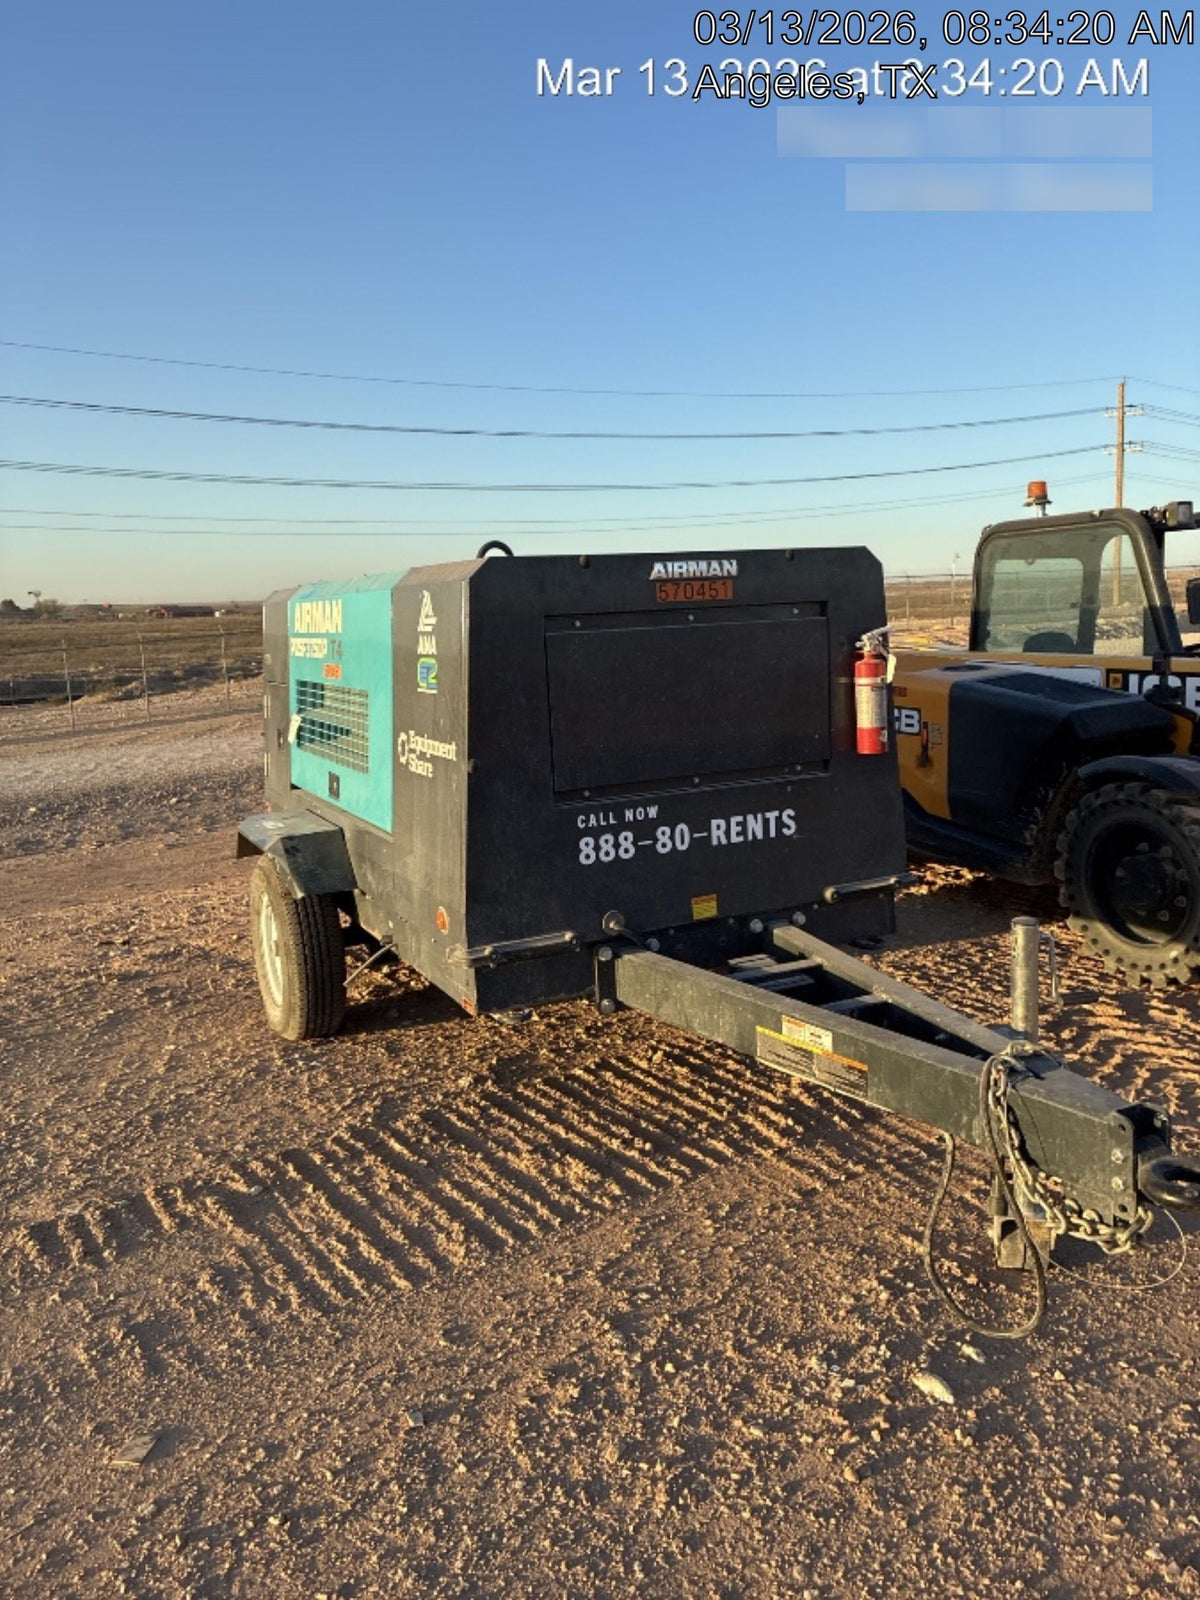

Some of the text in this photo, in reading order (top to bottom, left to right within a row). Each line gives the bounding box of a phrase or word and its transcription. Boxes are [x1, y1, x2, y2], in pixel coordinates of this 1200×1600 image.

[649, 559, 738, 580] AIRMAN
[657, 580, 729, 601] 570451
[294, 599, 342, 634] AIRMAN
[408, 730, 457, 762] Equipment
[408, 753, 433, 778] Share
[577, 805, 659, 829] CALL NOW
[579, 808, 797, 865] 888-80-RENTS
